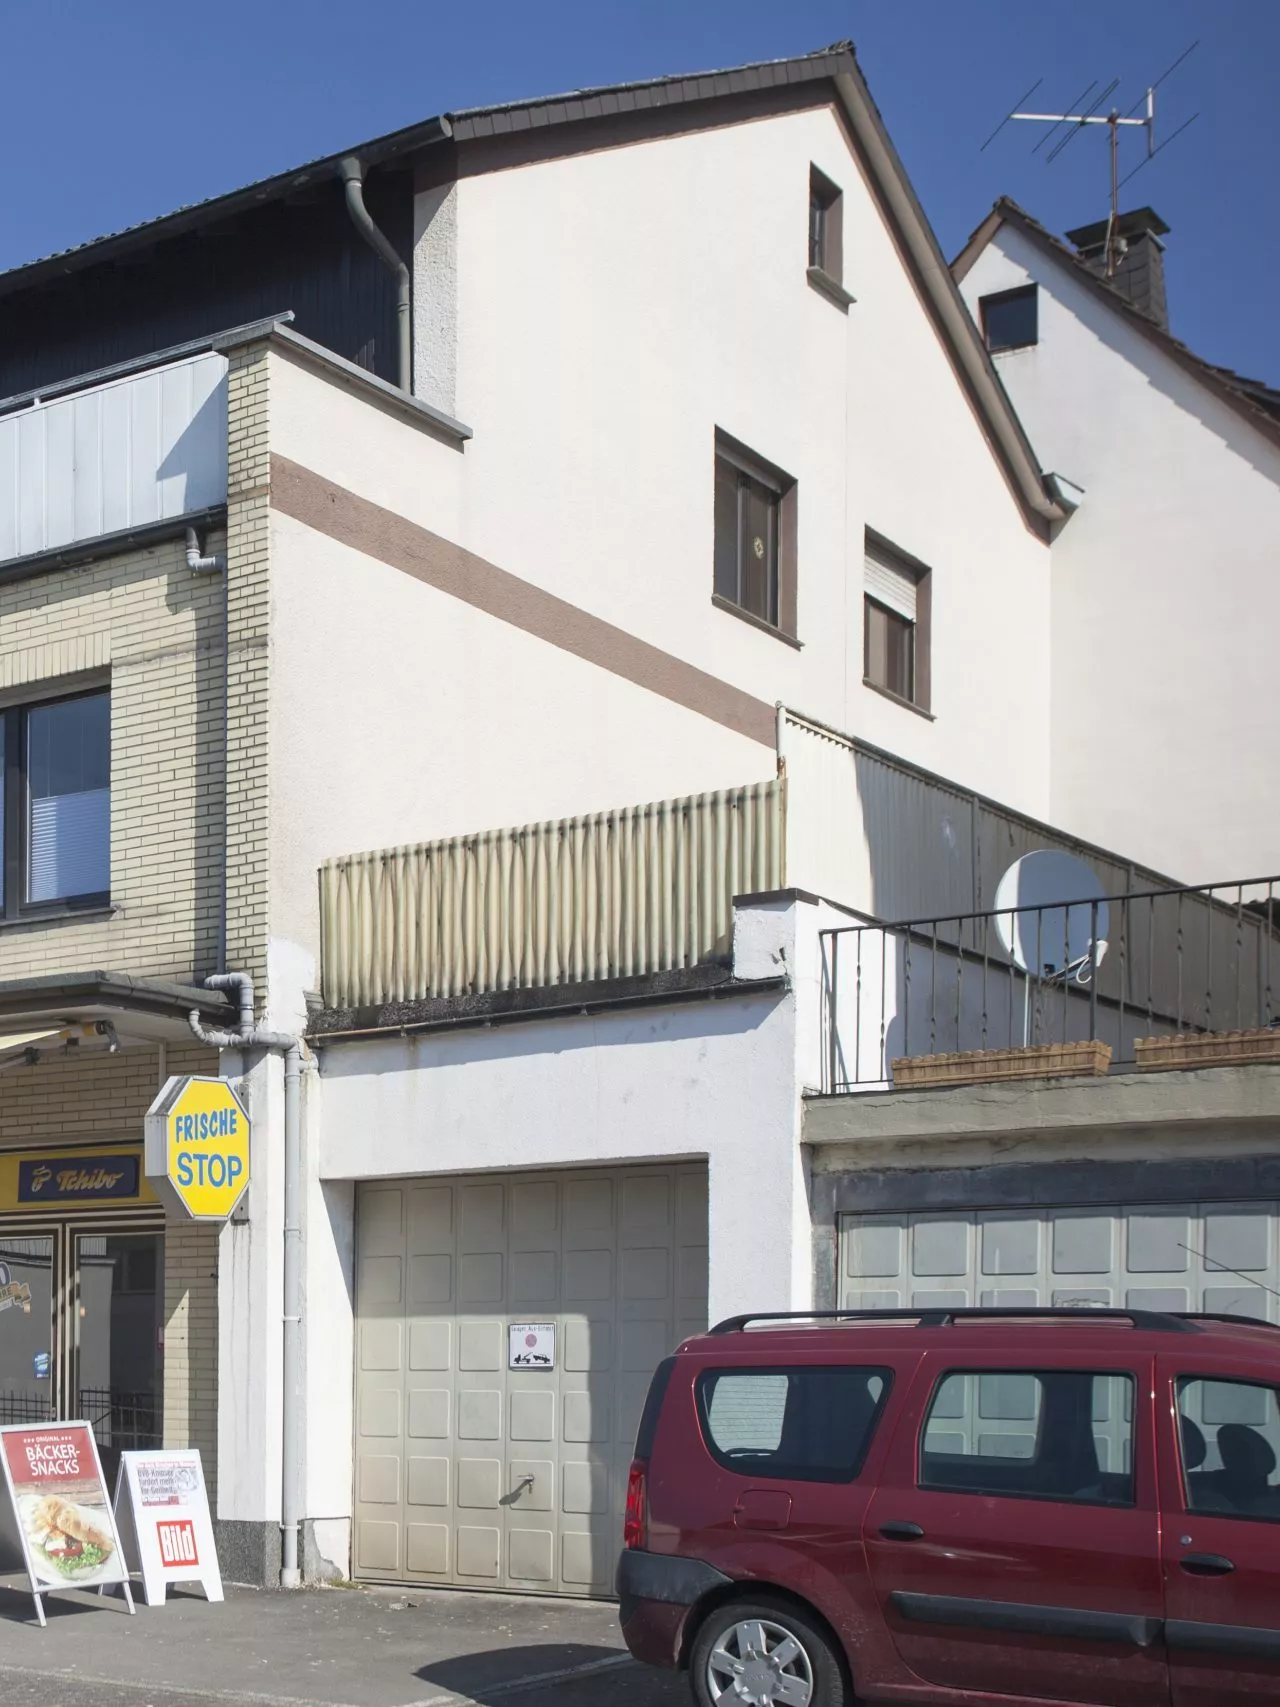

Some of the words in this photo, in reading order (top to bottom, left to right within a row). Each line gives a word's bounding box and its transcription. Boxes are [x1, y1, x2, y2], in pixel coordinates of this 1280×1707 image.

[175, 1108, 238, 1143] FRISCHE
[56, 1168, 125, 1191] Tchibo
[177, 1152, 243, 1187] STOP
[25, 1444, 80, 1461] BÄCKER-
[30, 1459, 80, 1476] SNACKS
[160, 1524, 196, 1562] Bild
